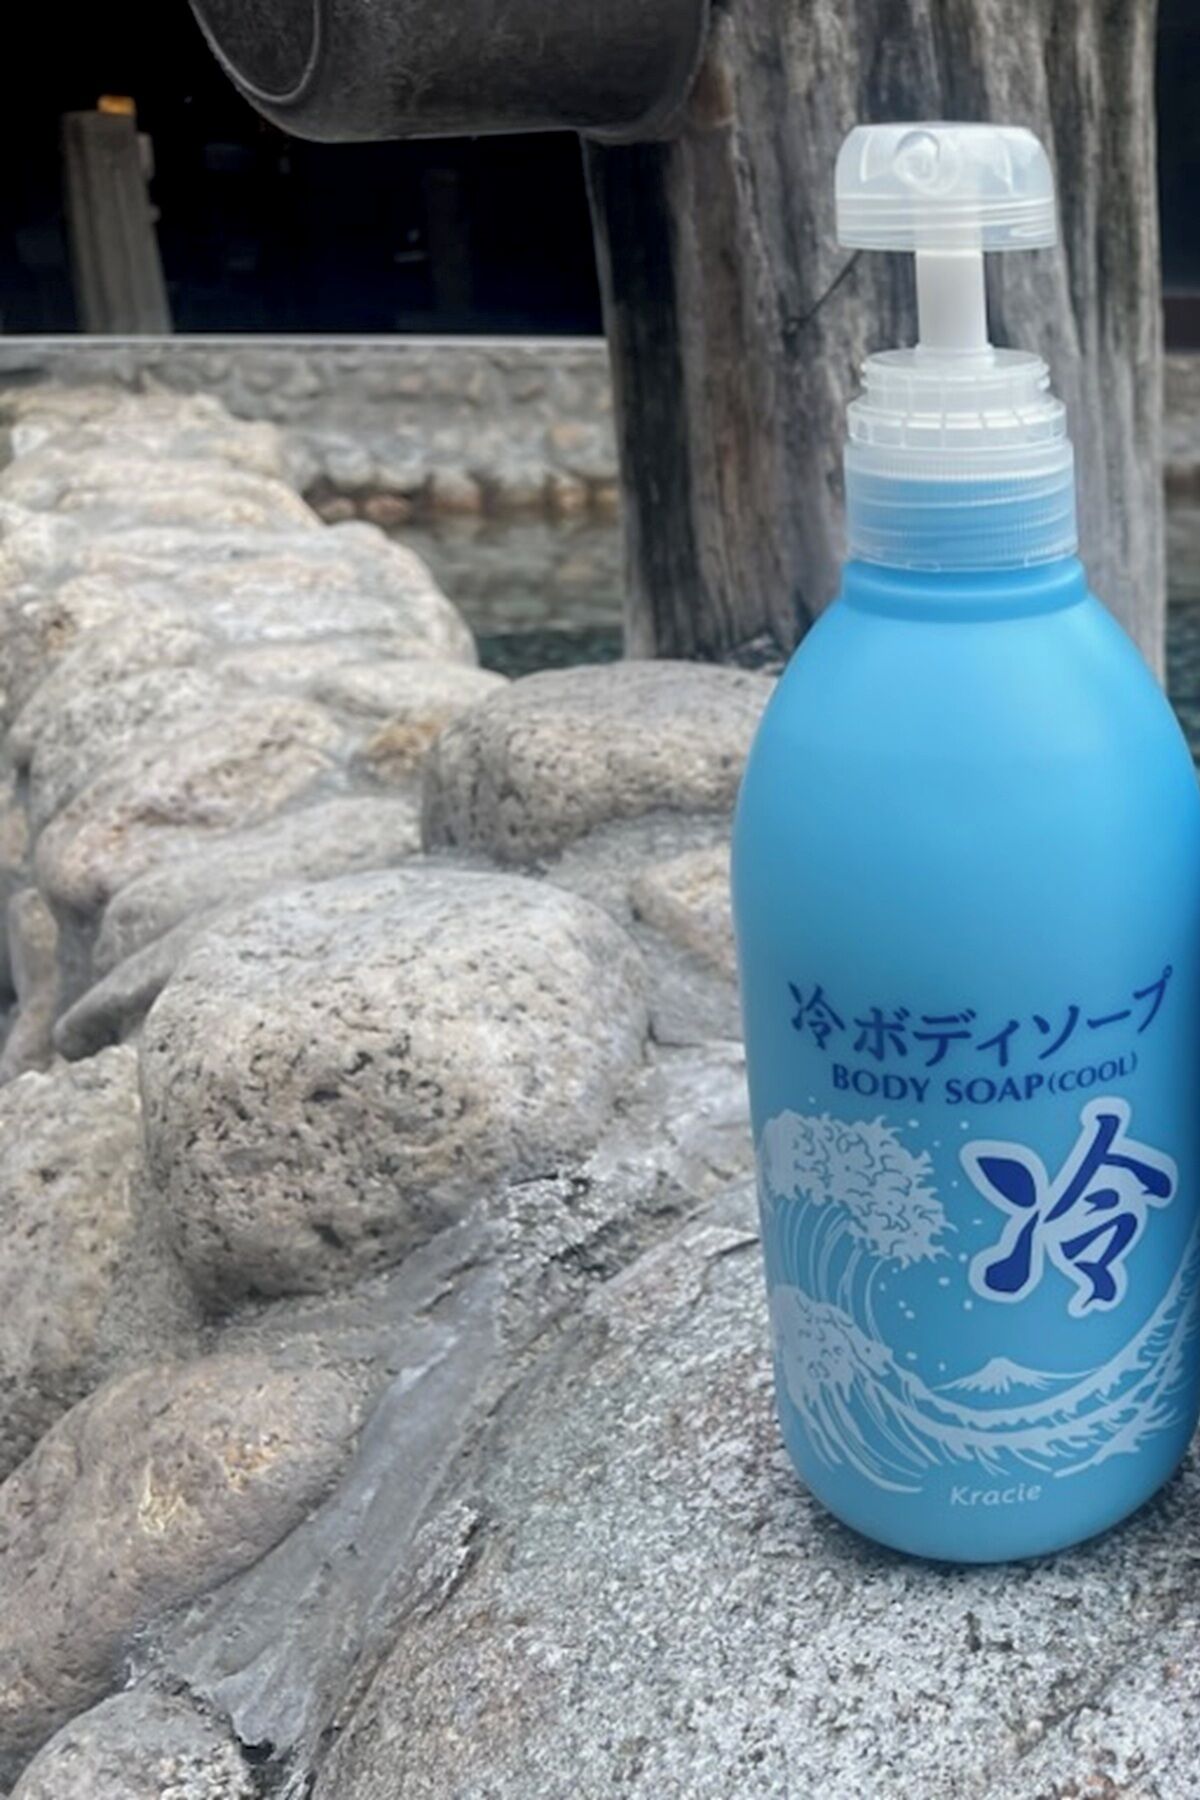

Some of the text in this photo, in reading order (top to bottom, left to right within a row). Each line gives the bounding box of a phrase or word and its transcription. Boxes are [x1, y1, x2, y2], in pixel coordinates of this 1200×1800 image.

[787, 964, 1174, 1068] 冷ボディソープ
[831, 1062, 931, 1104] BODY
[968, 1105, 1175, 1312] 冷
[949, 1481, 1043, 1507] Kracie
